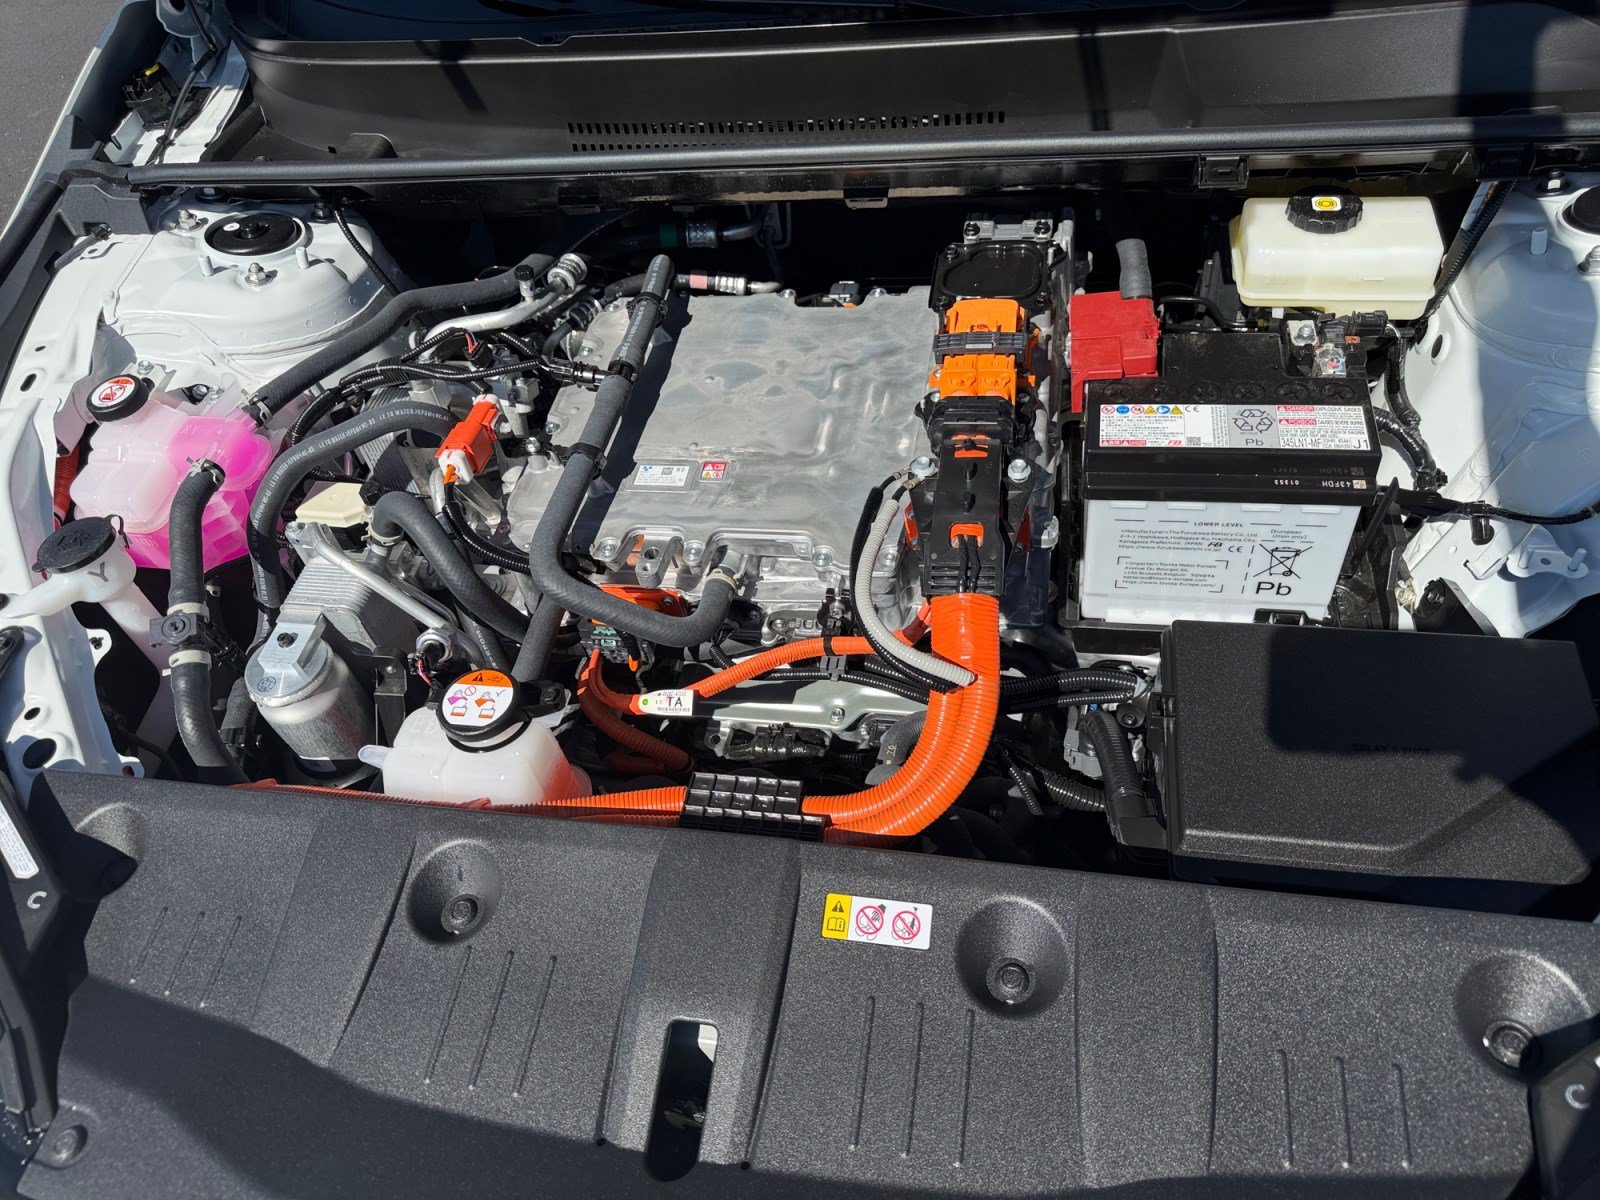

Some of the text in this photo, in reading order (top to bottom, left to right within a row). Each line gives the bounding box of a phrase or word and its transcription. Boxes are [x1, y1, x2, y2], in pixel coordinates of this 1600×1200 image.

[1228, 545, 1243, 553] CE
[1256, 581, 1292, 596] Pb
[666, 696, 682, 707] TA
